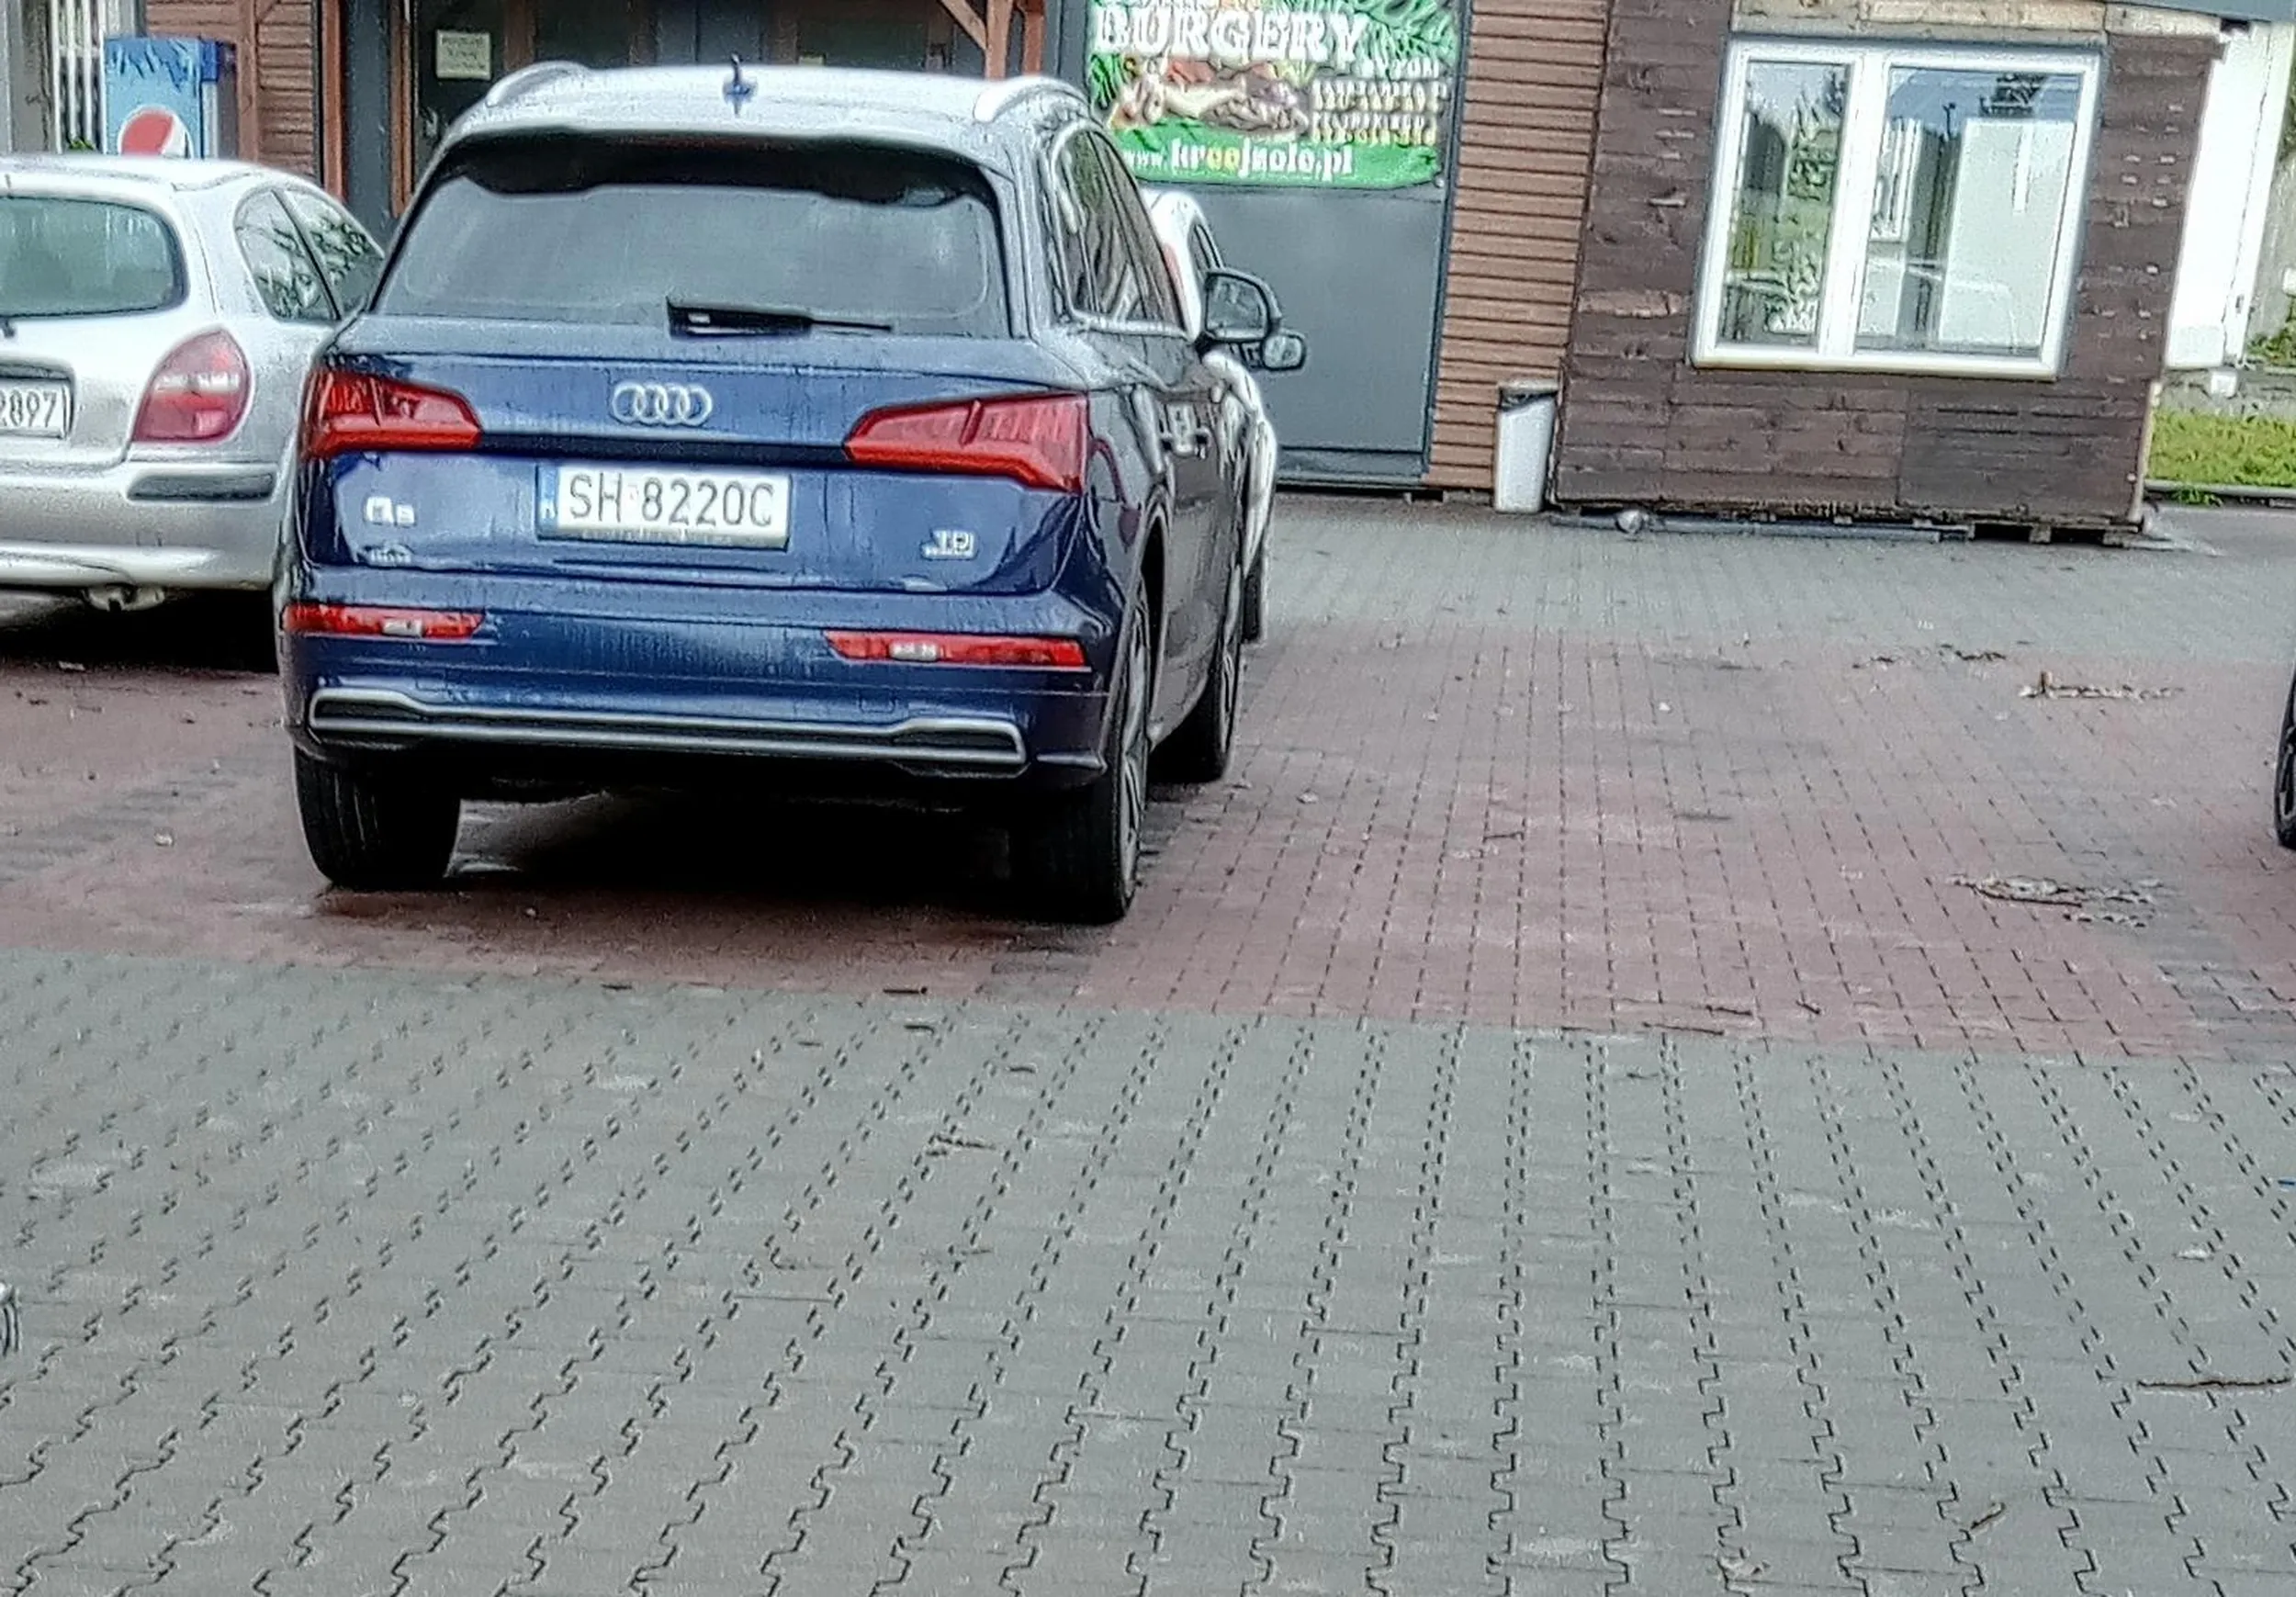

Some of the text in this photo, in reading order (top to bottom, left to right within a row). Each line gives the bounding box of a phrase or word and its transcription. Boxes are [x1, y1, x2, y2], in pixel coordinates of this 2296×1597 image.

[1097, 5, 1367, 71] BURGERY
[568, 472, 623, 523] SH
[642, 477, 774, 527] 8220C
